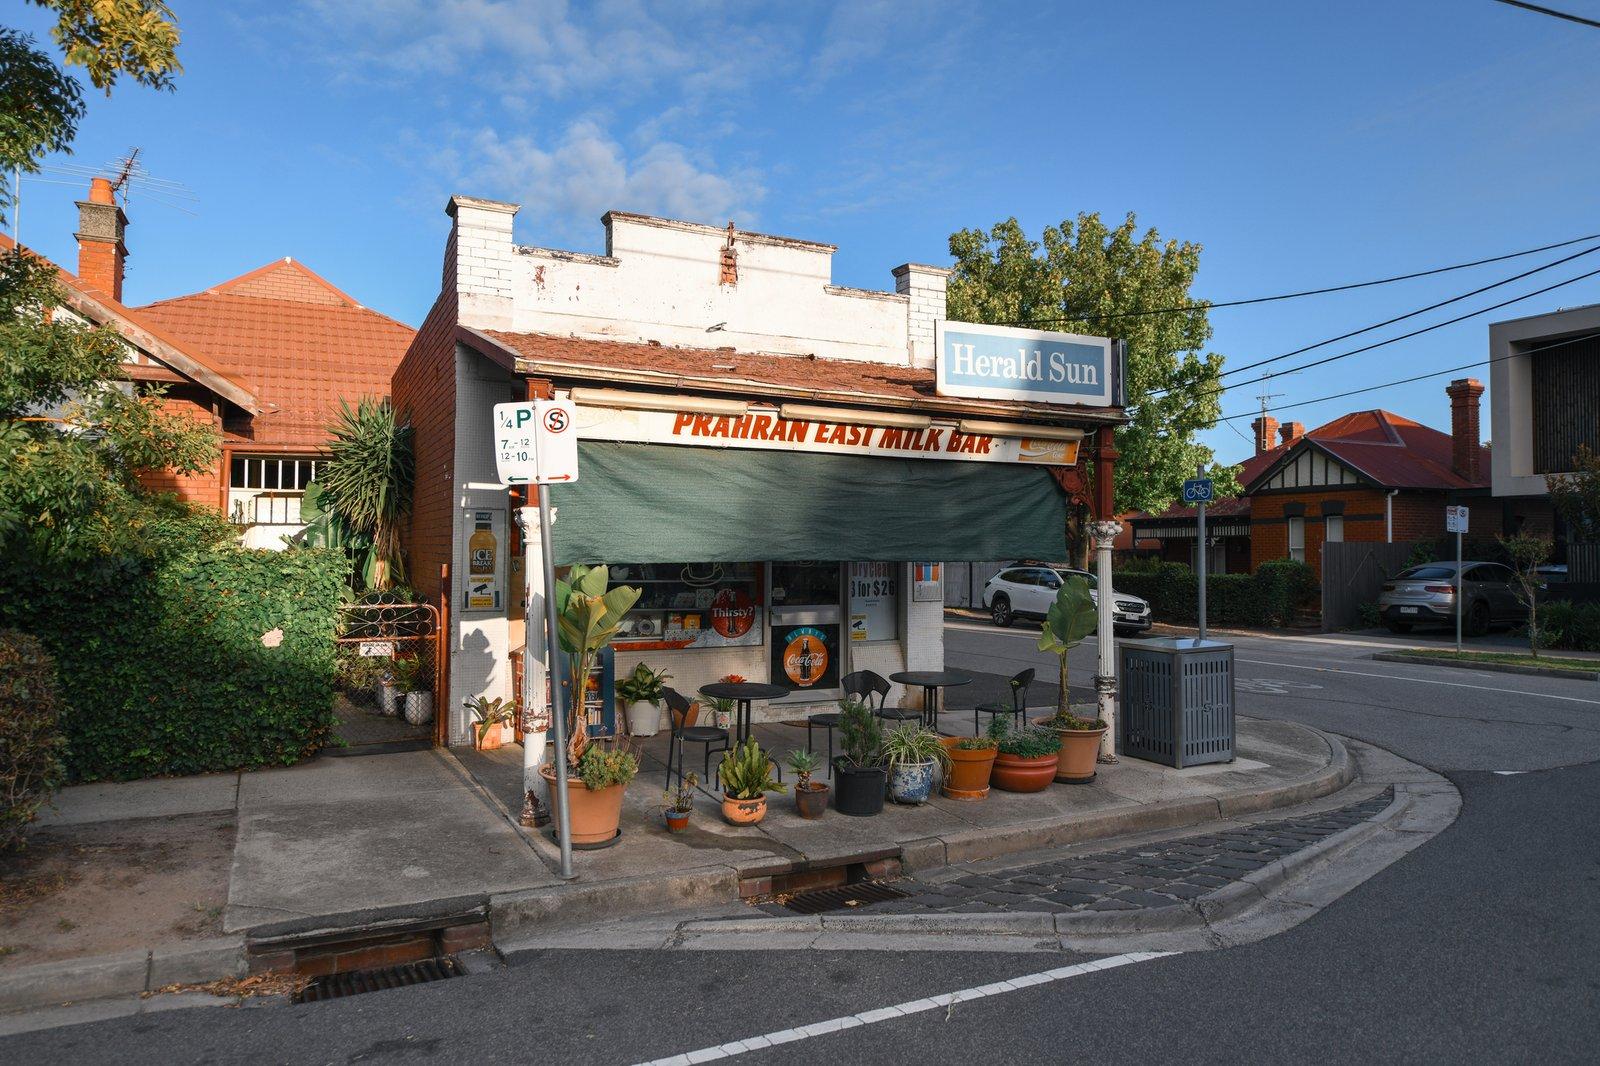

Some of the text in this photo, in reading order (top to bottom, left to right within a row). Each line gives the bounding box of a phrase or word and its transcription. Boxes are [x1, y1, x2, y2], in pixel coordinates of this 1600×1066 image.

[952, 343, 1098, 385] Herald Sun
[672, 412, 993, 454] PRAHRAN EAST MILK BAR
[473, 549, 493, 560] ICE
[851, 581, 856, 598] 3
[858, 580, 871, 598] for
[873, 580, 895, 598] $26
[712, 606, 754, 619] Thirsty?
